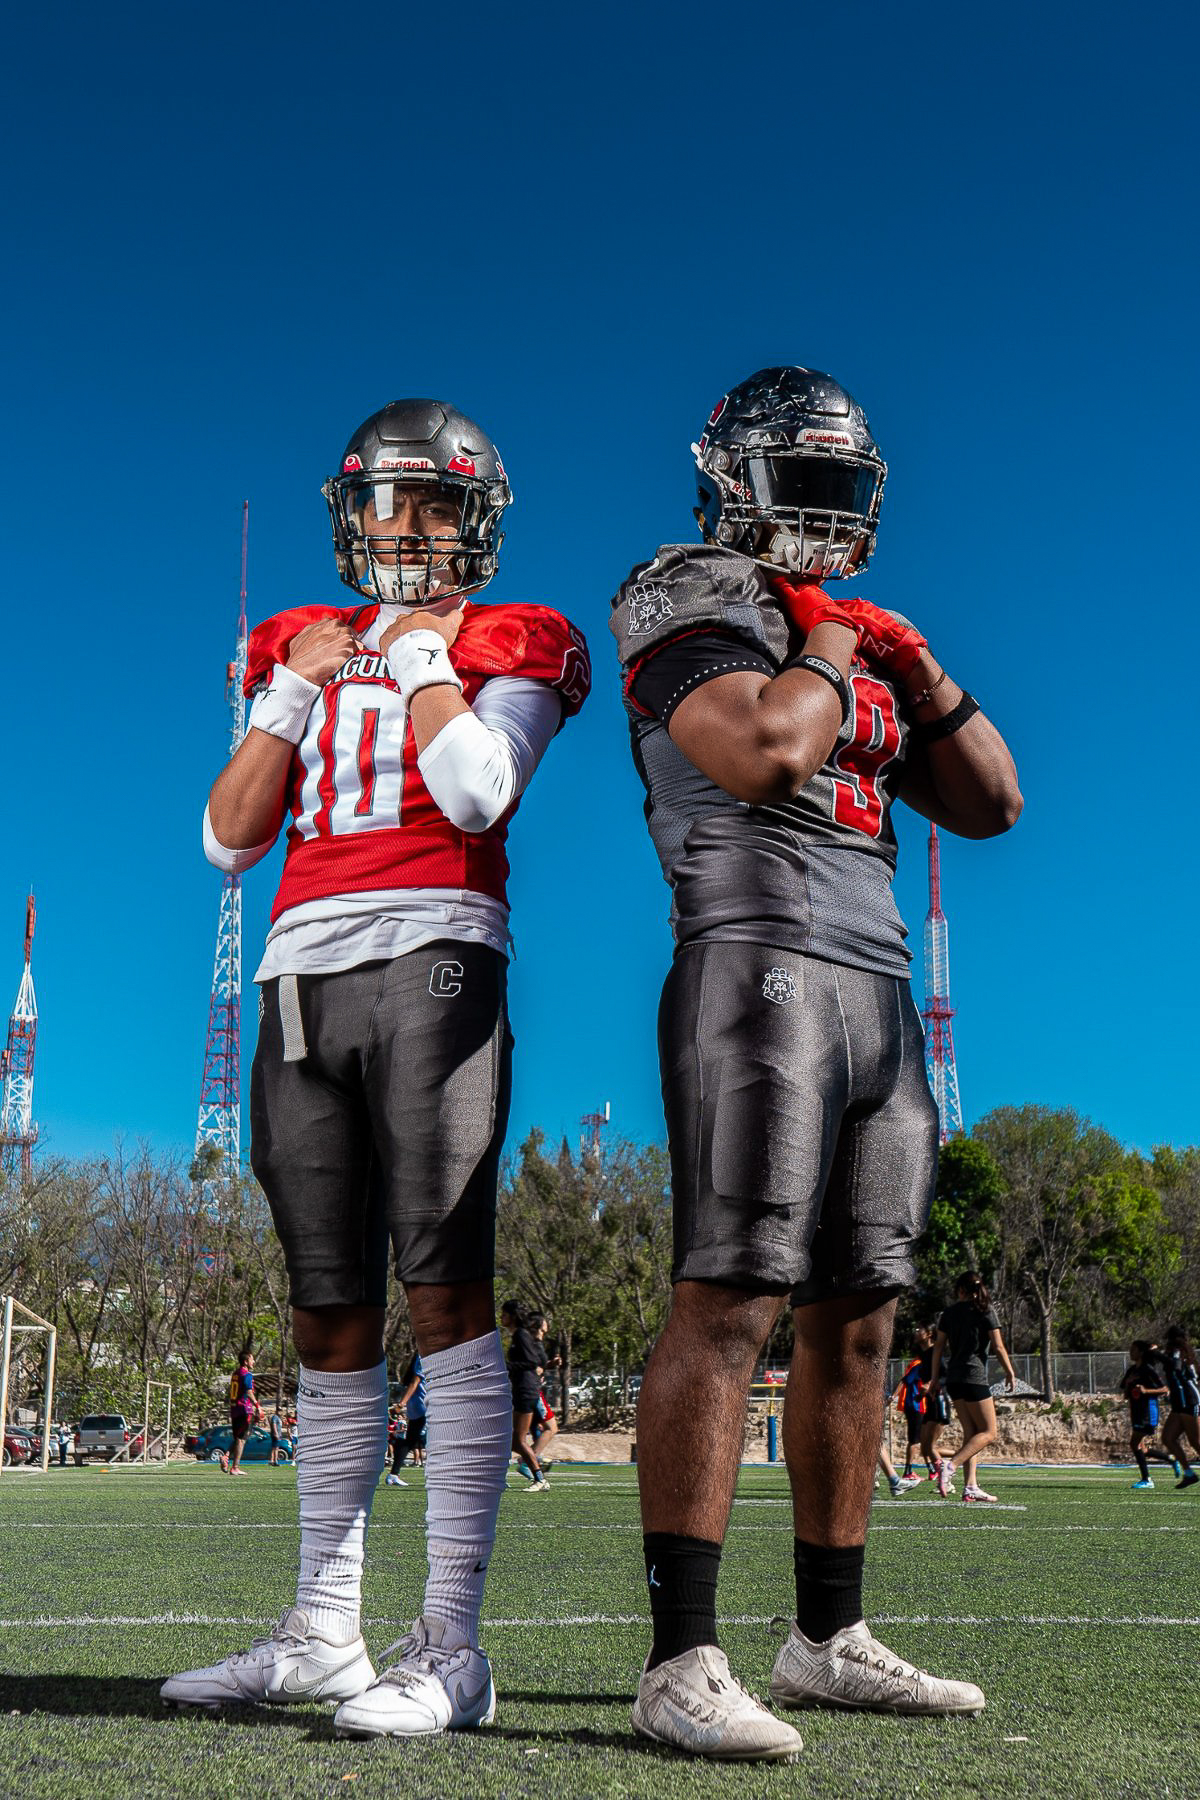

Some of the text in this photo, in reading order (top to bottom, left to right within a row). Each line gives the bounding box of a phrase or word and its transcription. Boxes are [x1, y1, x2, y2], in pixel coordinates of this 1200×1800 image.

[381, 460, 429, 469] Riddell
[832, 673, 902, 839] 9
[428, 960, 464, 997] C
